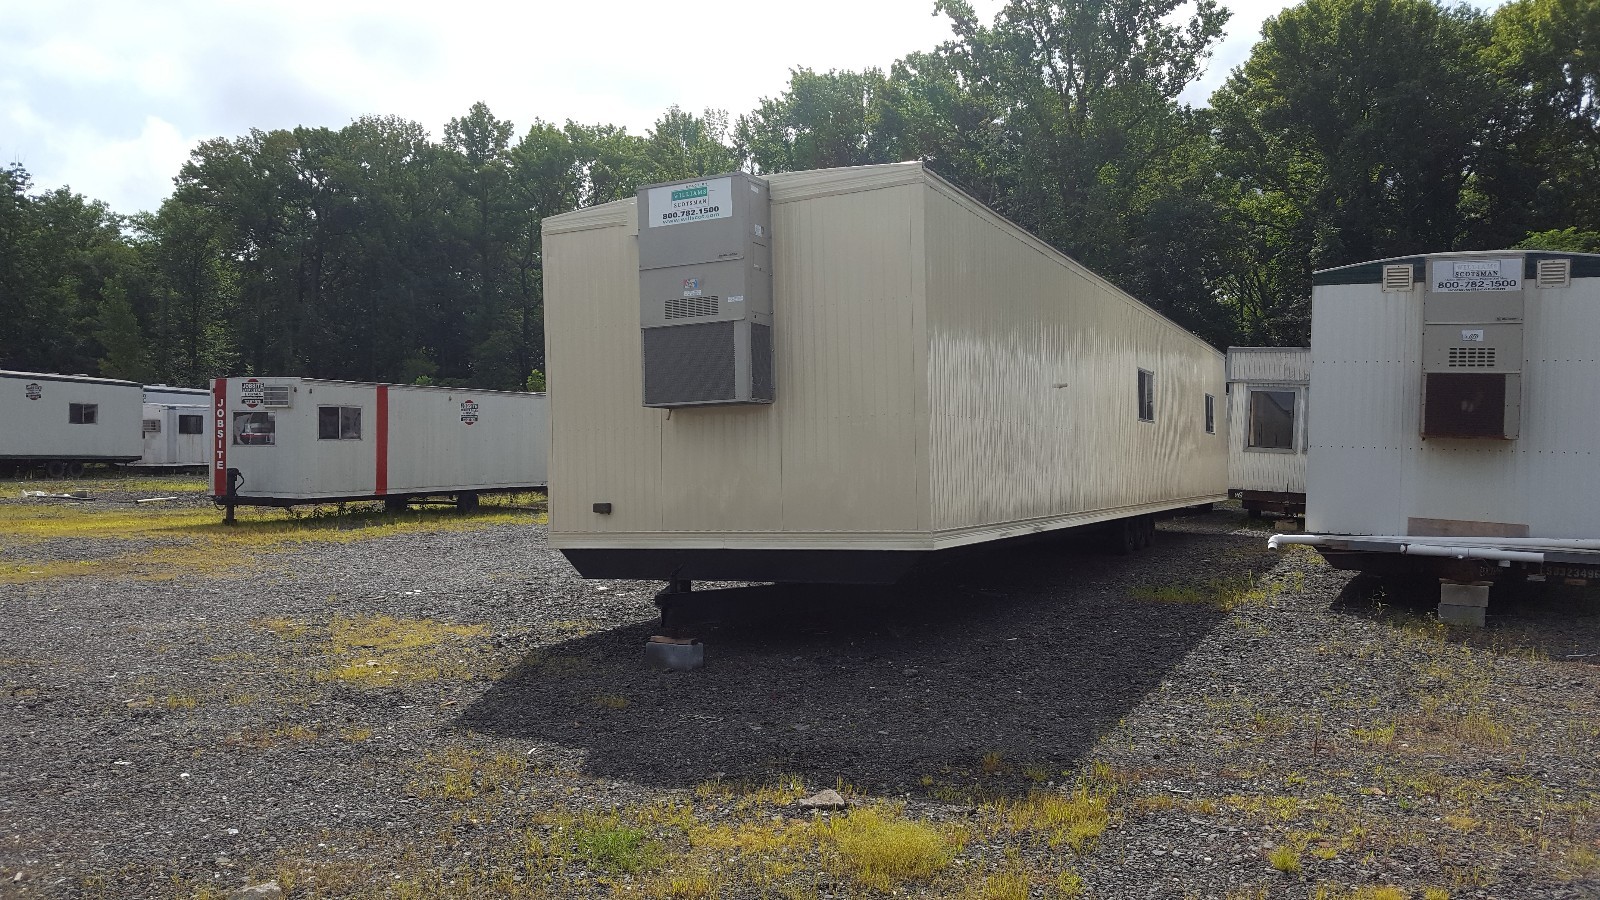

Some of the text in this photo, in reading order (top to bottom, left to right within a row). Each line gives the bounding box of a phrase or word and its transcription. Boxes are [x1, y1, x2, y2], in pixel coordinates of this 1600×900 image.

[673, 189, 707, 199] WILLIAMS
[673, 199, 707, 208] SCOTSMAN
[662, 206, 720, 220] 800.782.1500
[1437, 280, 1517, 289] 800-782-1500
